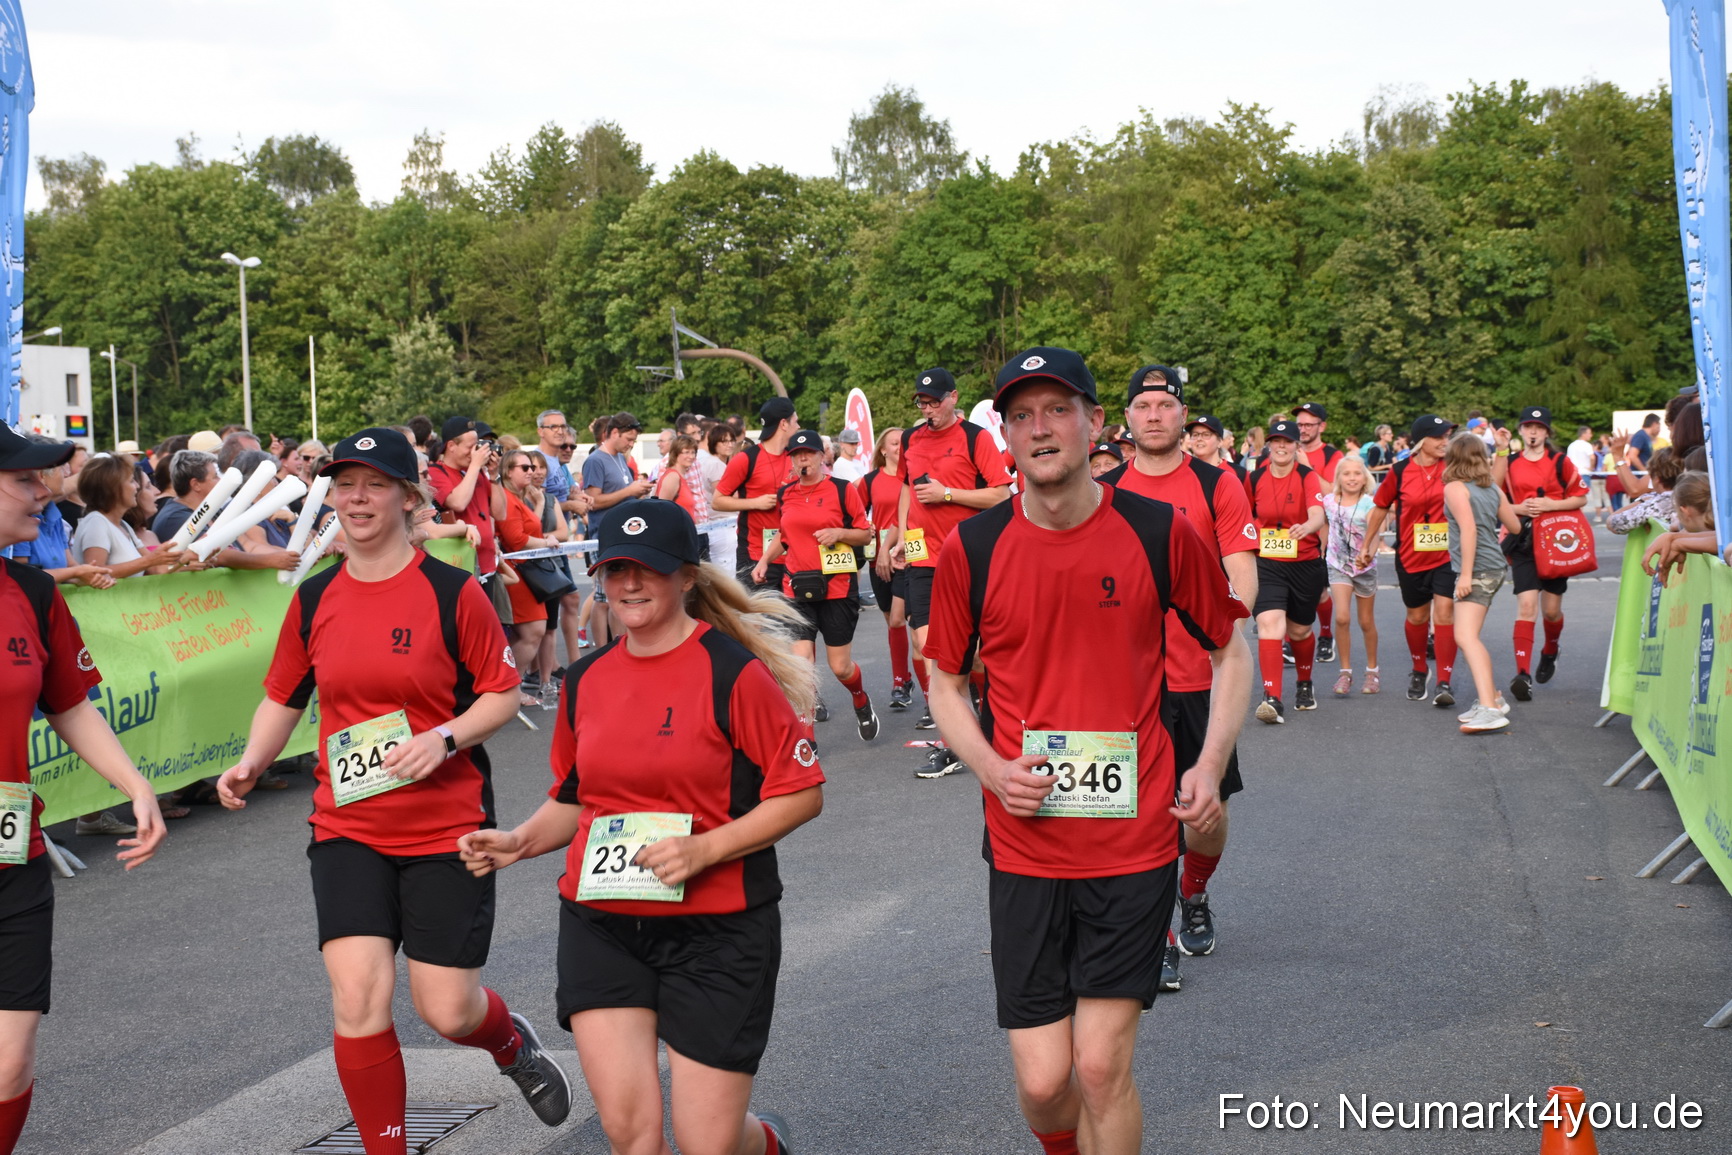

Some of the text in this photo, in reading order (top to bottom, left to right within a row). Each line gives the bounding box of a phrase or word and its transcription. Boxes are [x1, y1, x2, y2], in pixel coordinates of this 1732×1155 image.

[1264, 538, 1292, 550] 2348
[1419, 533, 1448, 544] 2364
[825, 552, 853, 566] 2329
[1102, 576, 1115, 599] 9
[1098, 600, 1121, 608] STEFAN
[121, 590, 229, 636] Gesunde Firmen
[391, 627, 411, 647] 91
[7, 637, 30, 658] 42
[661, 706, 673, 728] 1
[1039, 747, 1084, 757] firmenlauf
[1109, 754, 1131, 762] 2019
[1048, 794, 1110, 802] Latuski Stefan
[591, 843, 648, 875] 234
